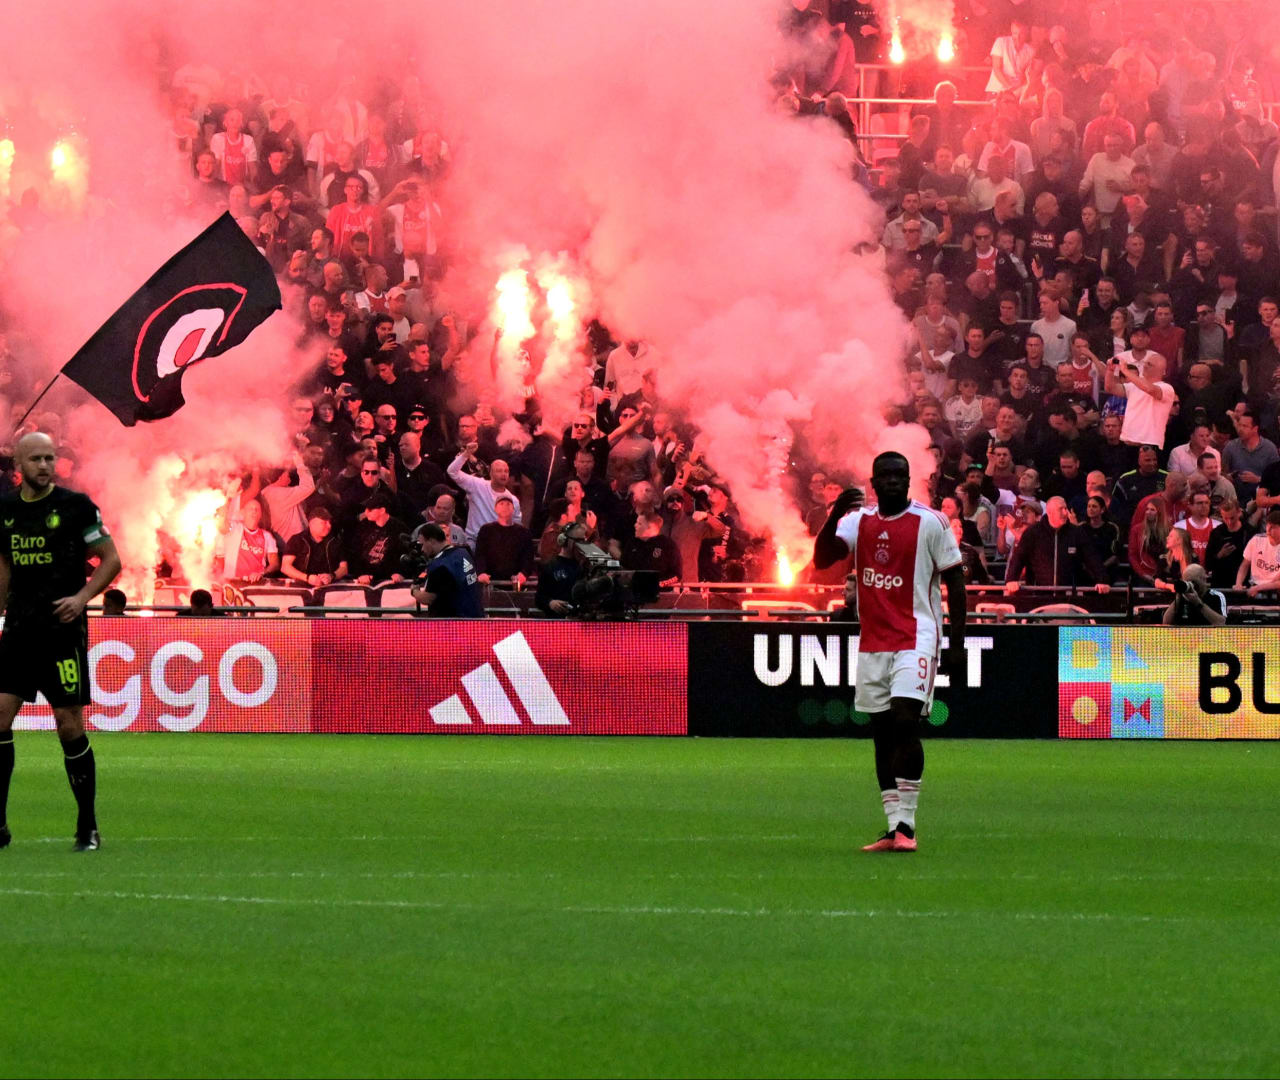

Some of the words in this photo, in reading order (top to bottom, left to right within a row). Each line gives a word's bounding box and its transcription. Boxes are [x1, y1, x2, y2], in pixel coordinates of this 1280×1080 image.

[10, 533, 45, 549] Euro
[12, 549, 52, 566] Parcs
[862, 567, 903, 589] Ziggo
[56, 658, 78, 685] 18
[754, 634, 994, 687] UNIT
[917, 657, 928, 680] 9
